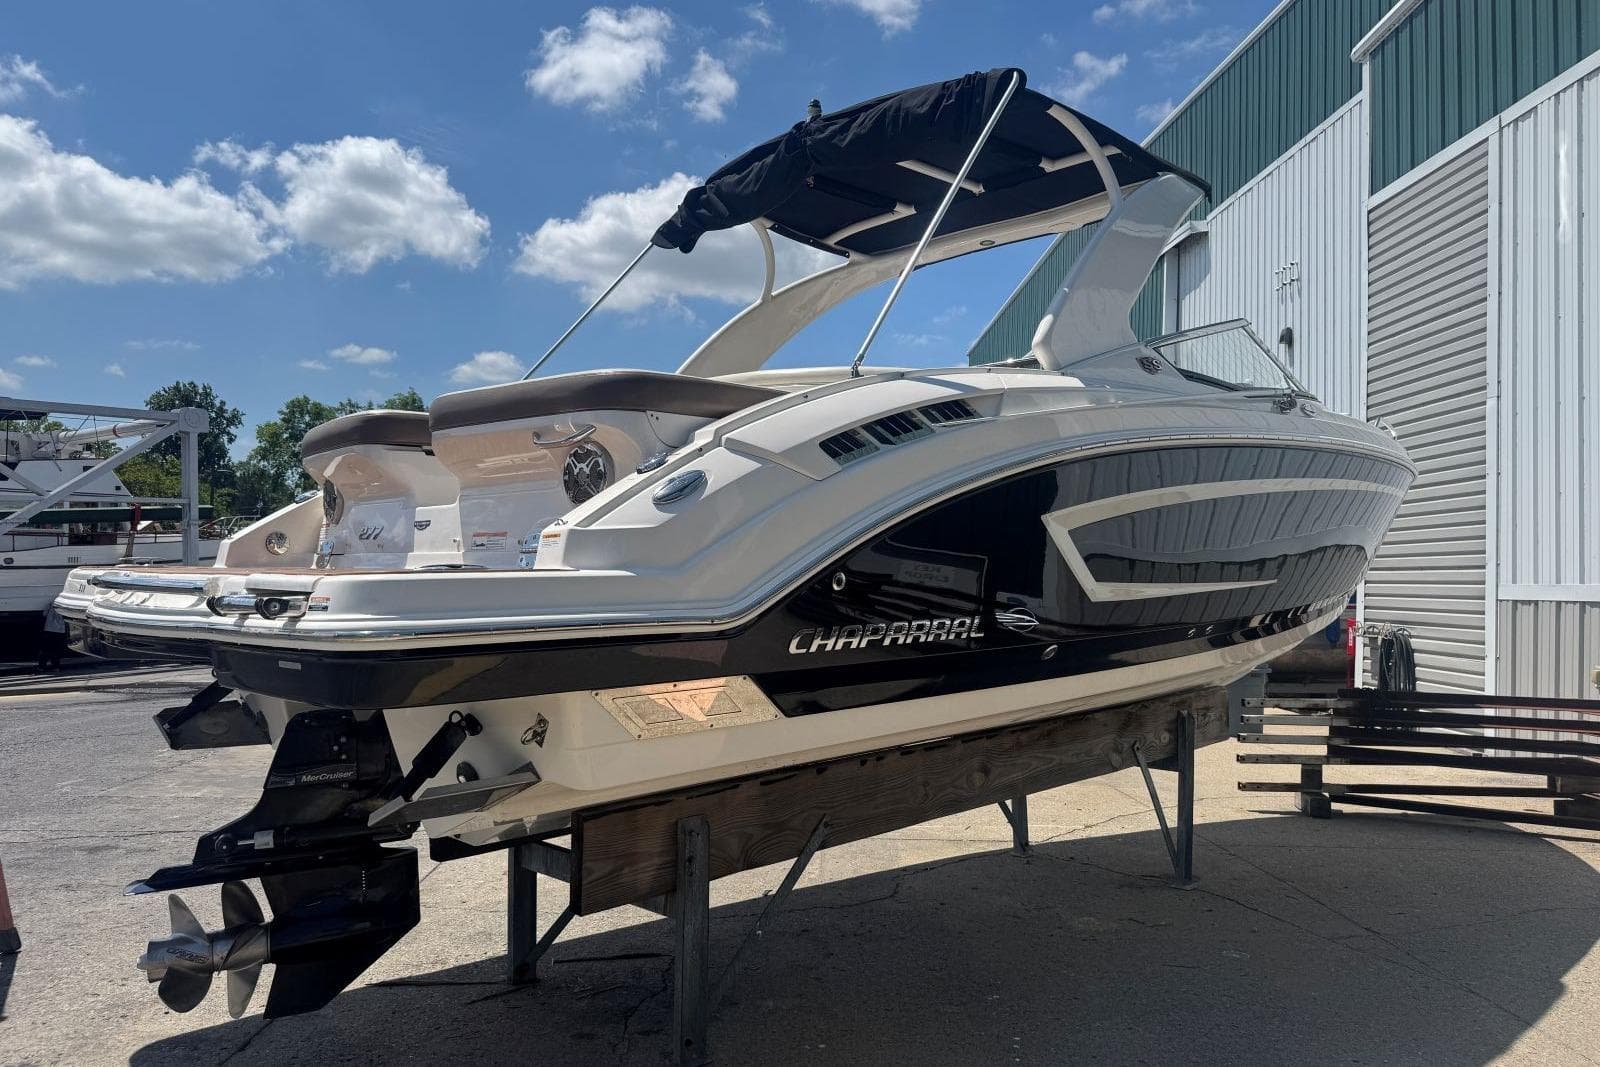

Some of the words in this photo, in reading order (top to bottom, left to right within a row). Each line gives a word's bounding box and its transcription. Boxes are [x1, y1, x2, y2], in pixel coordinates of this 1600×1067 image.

[358, 526, 385, 540] 277
[788, 615, 985, 655] CHAPARRAL
[301, 771, 354, 783] MerCruiser
